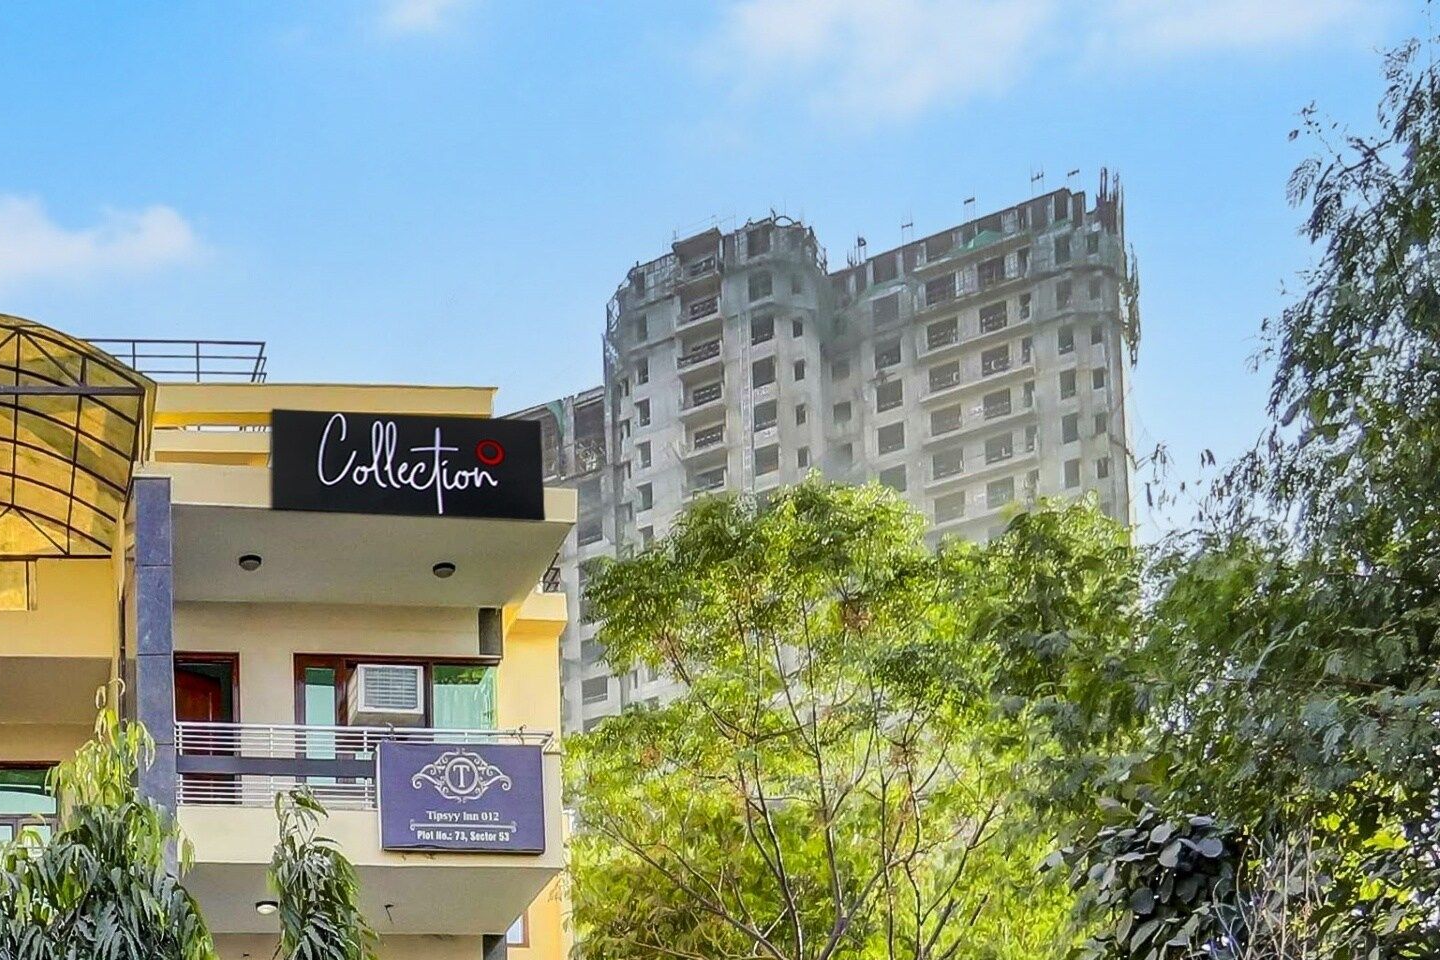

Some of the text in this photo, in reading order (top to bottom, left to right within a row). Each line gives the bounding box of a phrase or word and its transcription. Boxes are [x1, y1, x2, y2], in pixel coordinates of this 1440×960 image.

[318, 413, 498, 514] Collection
[426, 810, 500, 822] Tipsyy Inn 012
[417, 830, 434, 840] Plot
[470, 831, 497, 841] Sector
[498, 832, 510, 842] 53
